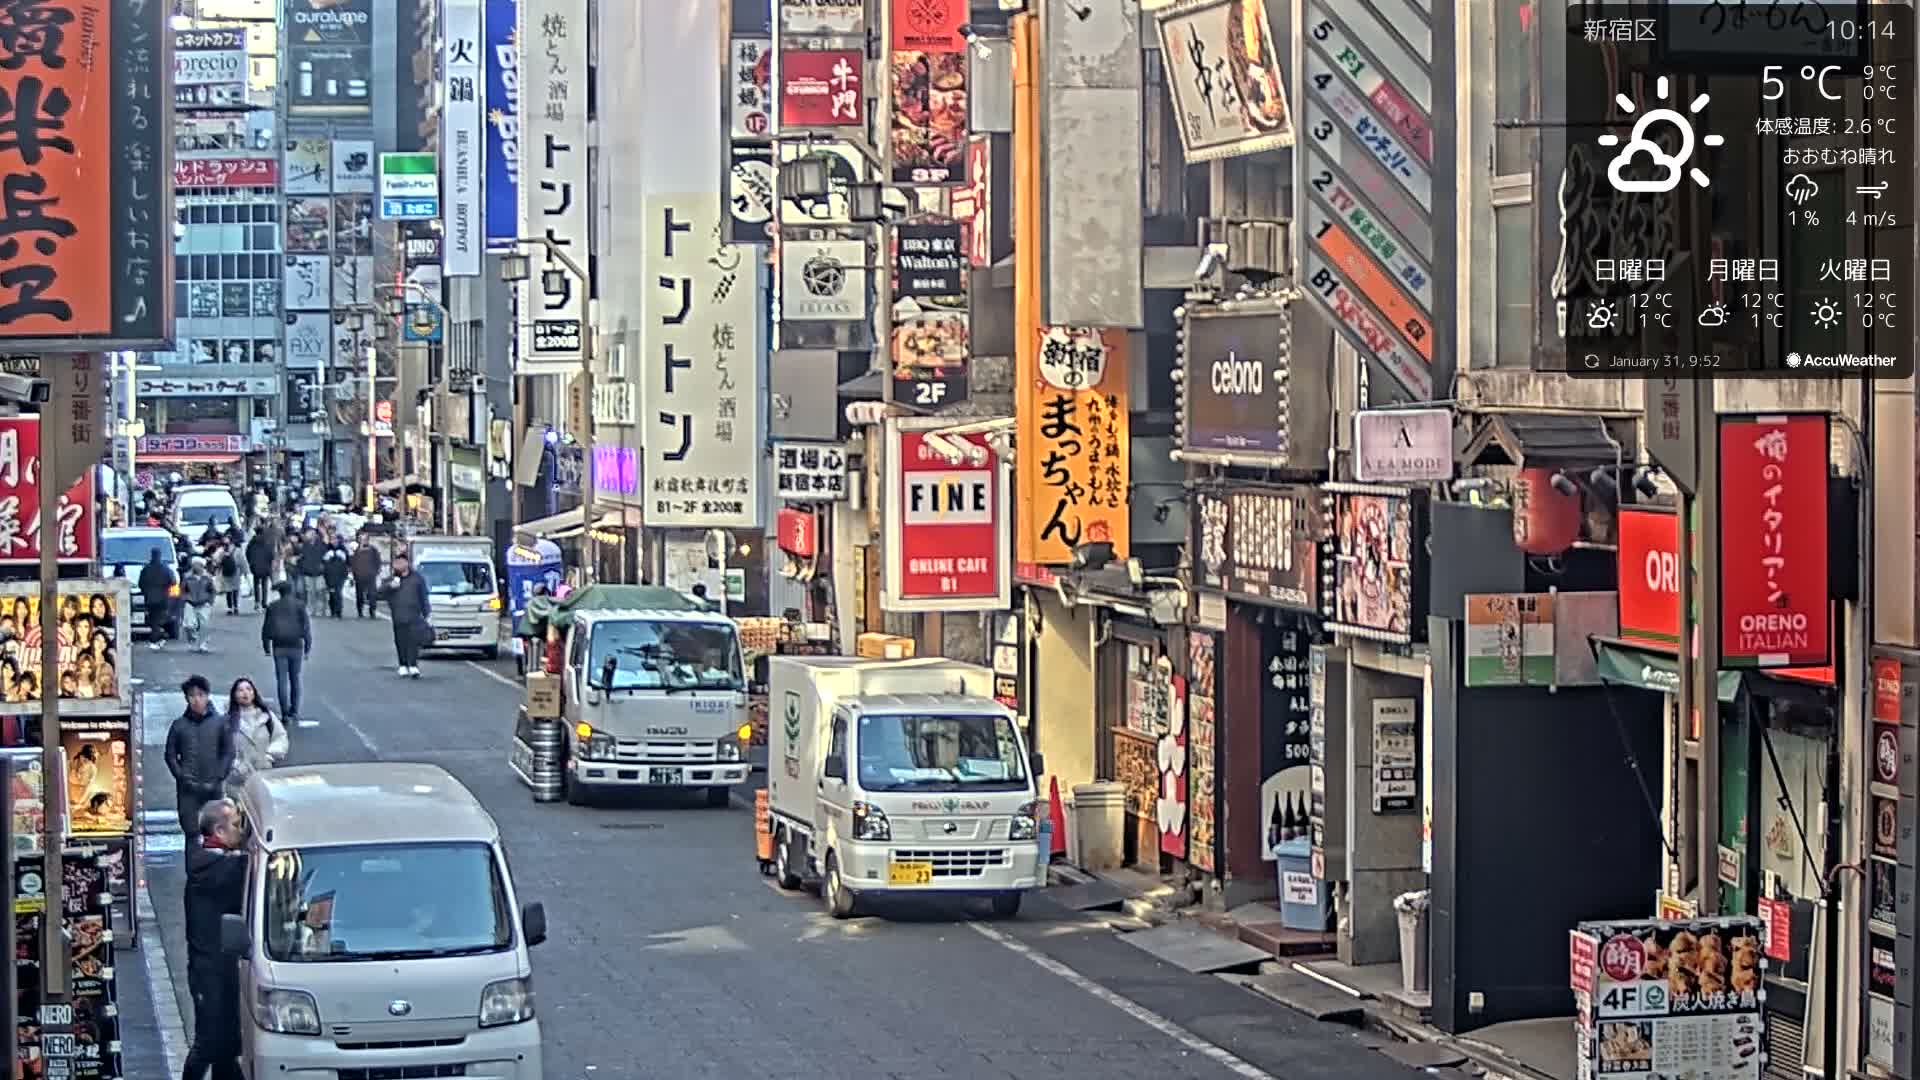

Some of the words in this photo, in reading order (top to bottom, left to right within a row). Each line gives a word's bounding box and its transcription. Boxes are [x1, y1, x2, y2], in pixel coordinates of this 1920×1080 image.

[1313, 20, 1334, 40] 5
[450, 38, 475, 103] 火鍋
[1314, 73, 1333, 91] 4
[1314, 121, 1333, 140] 3
[1312, 171, 1333, 191] 2
[1311, 268, 1339, 297] B1
[659, 208, 692, 461] トントン
[1043, 340, 1102, 372] 新宿
[916, 383, 947, 403] 2F
[779, 448, 843, 469] 酒場心
[1041, 395, 1085, 548] まっちゃん
[911, 483, 986, 512] FINE
[1754, 430, 1788, 602] 俺のイタリアン
[909, 558, 954, 574] ONLINE
[957, 557, 987, 573] CAFE
[1740, 613, 1807, 633] ORENO
[1738, 634, 1808, 650] ITALIAN
[646, 727, 689, 736] ISUZU
[1603, 986, 1638, 1011] 4F
[41, 1004, 72, 1024] NERO
[43, 1035, 74, 1054] NERO
